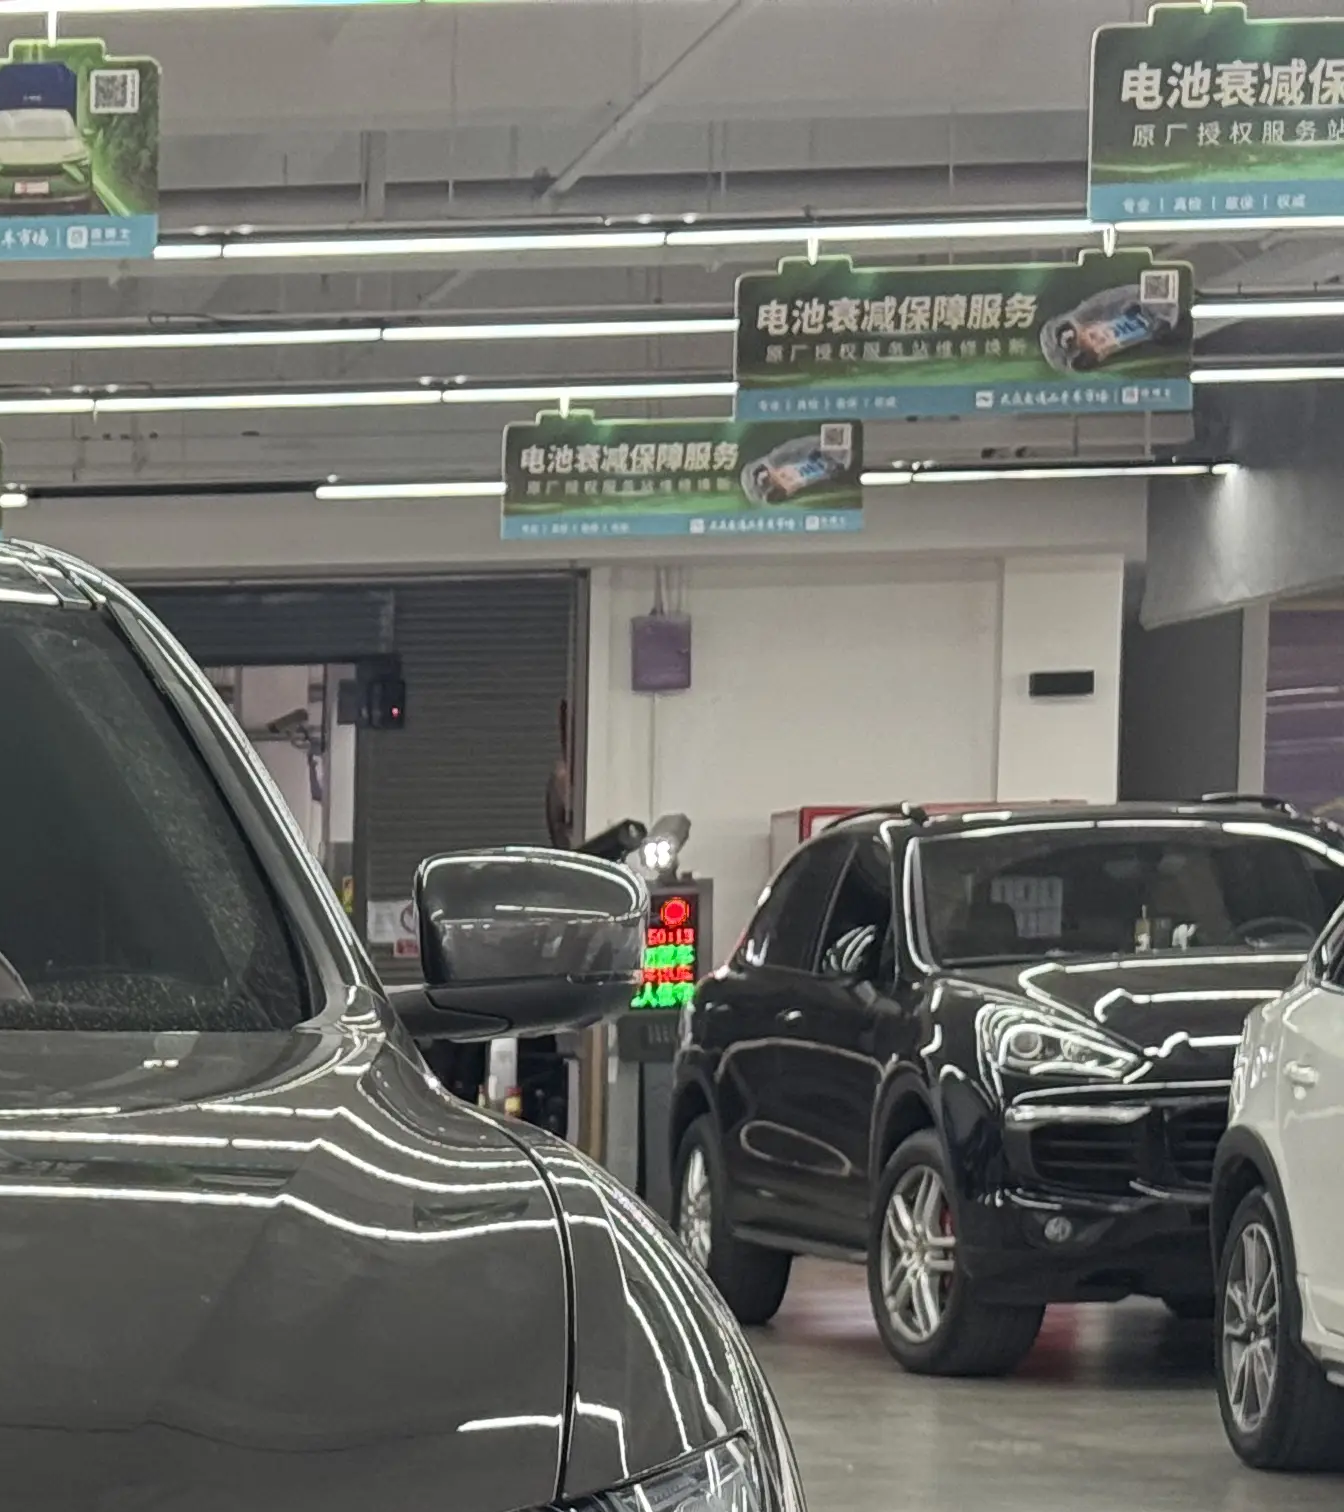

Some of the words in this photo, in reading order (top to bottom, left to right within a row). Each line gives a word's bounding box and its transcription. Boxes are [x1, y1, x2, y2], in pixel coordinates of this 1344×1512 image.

[1121, 57, 1344, 110] 电池衰减保
[757, 292, 1038, 335] 电池衰减保障服务
